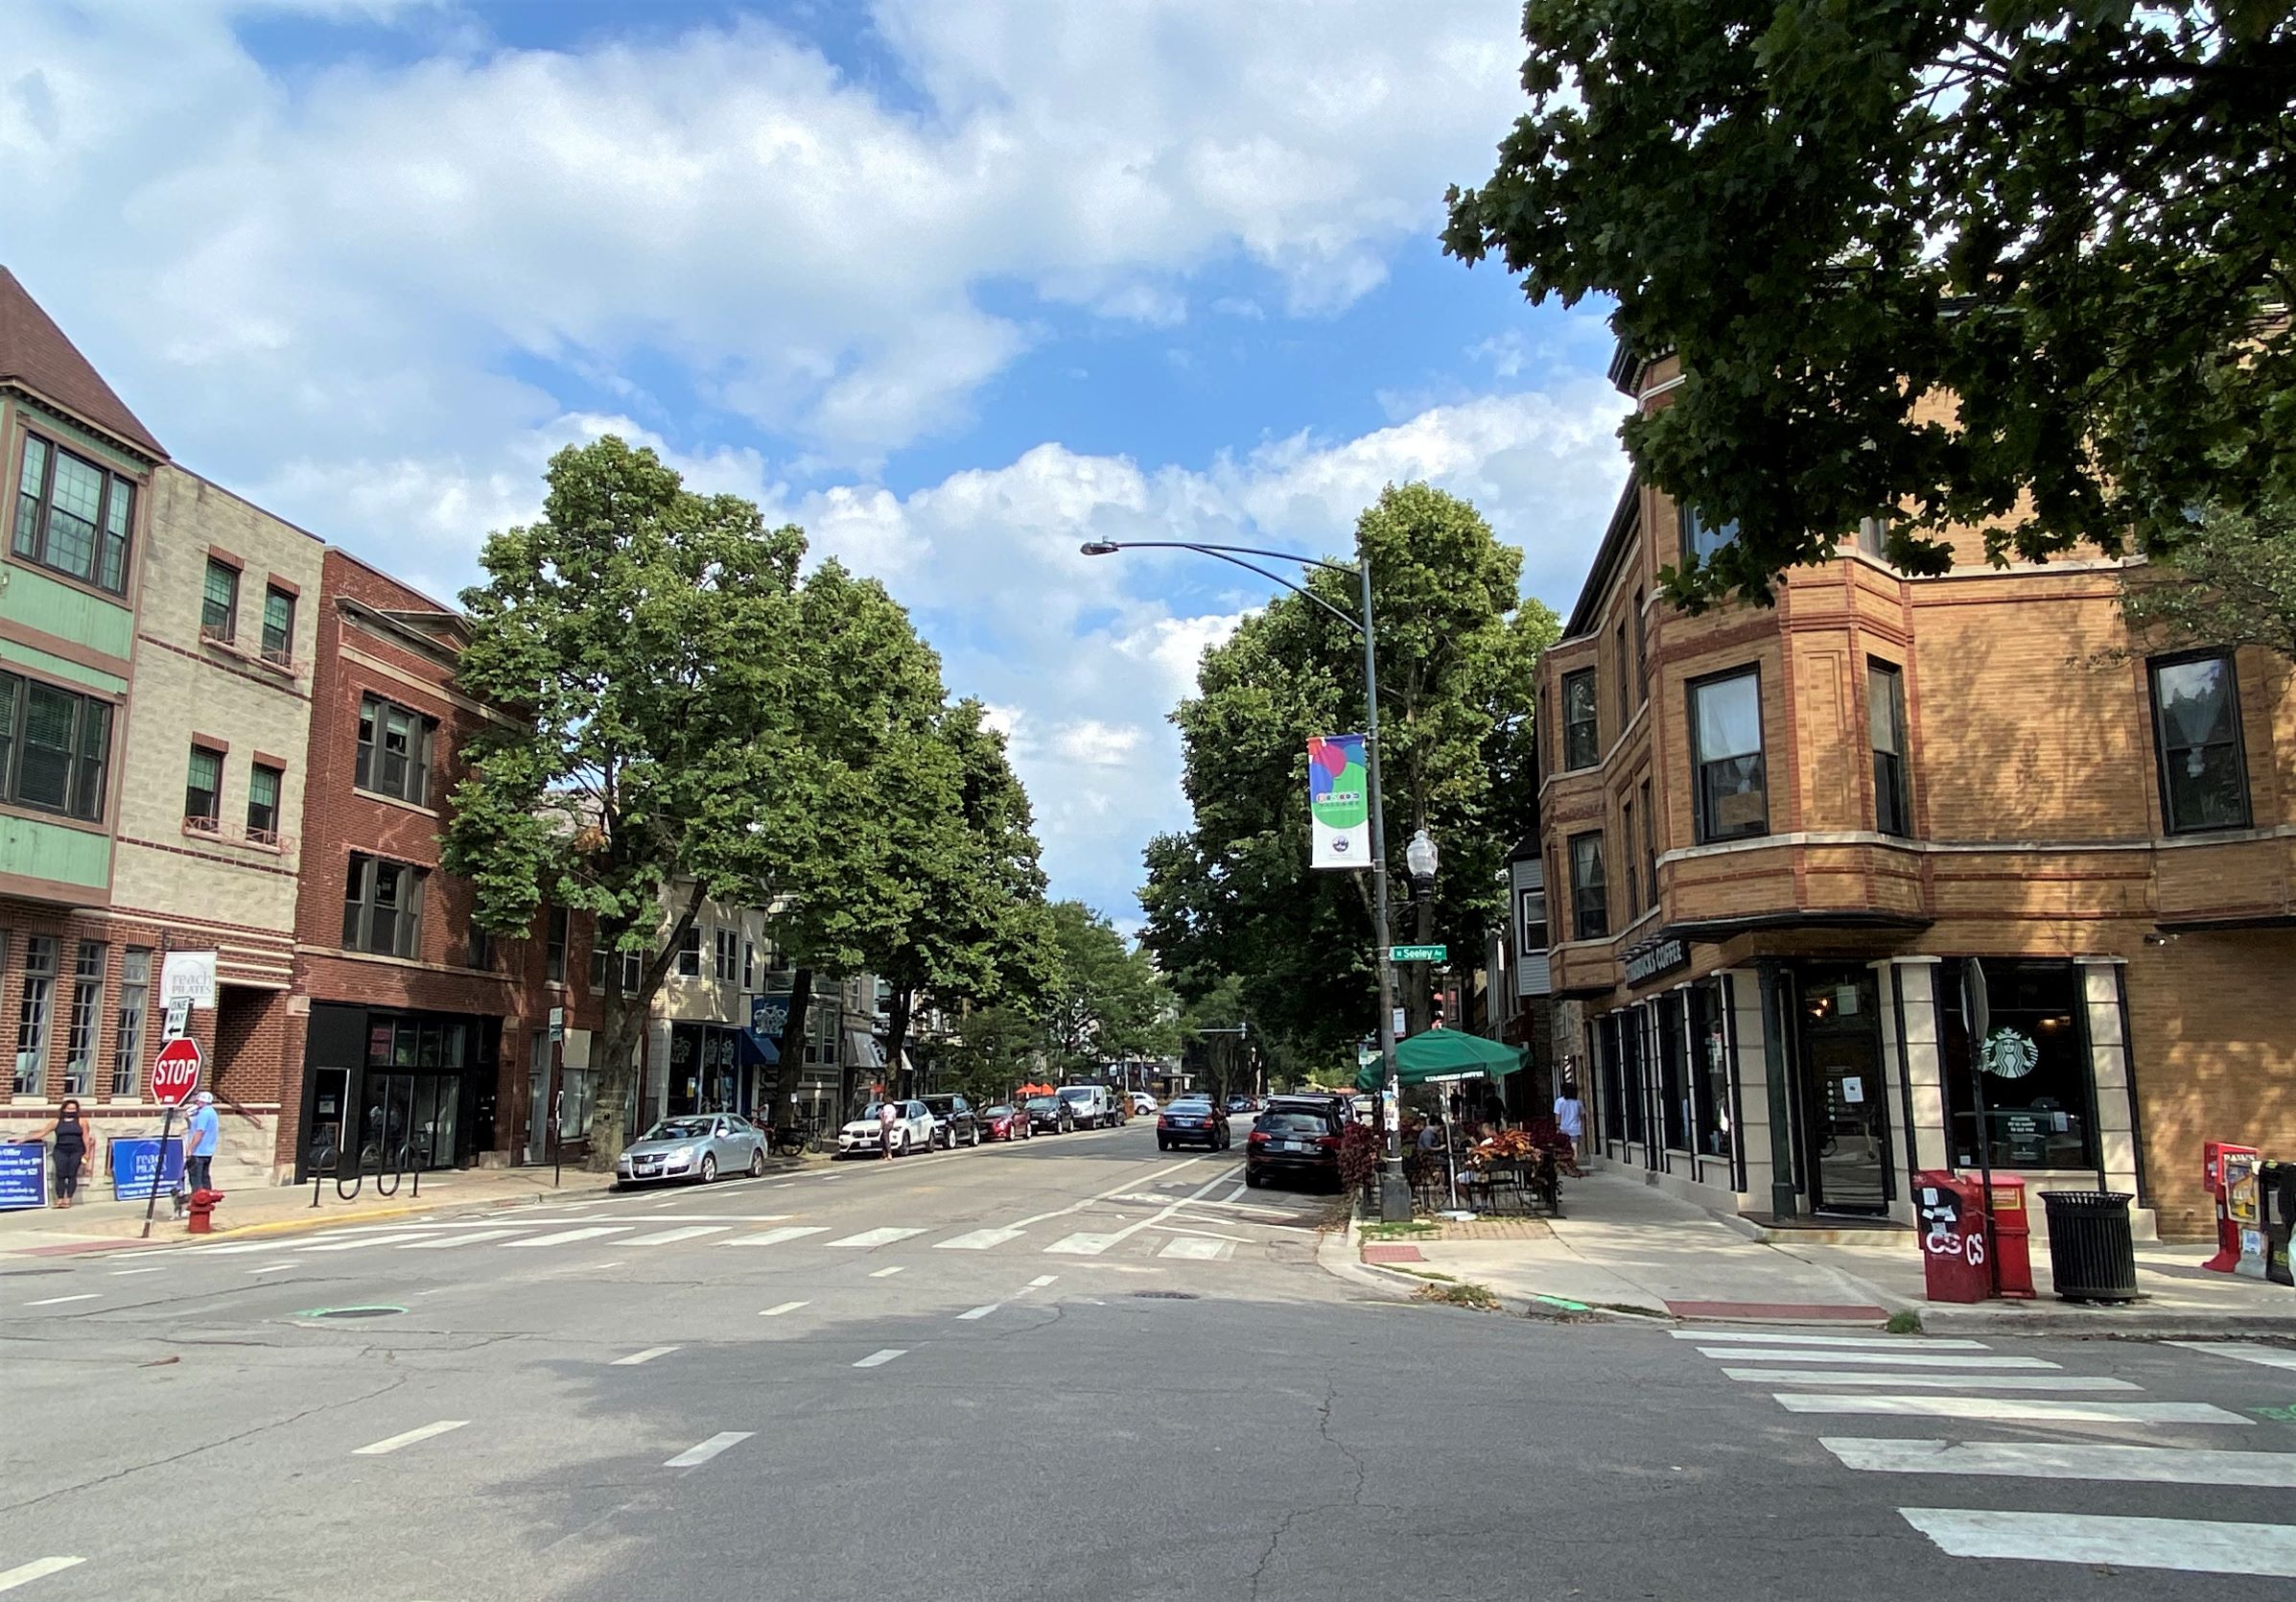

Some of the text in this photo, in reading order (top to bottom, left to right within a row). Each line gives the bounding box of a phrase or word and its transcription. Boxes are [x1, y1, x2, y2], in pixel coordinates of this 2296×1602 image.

[1403, 949, 1433, 960] Seeley
[172, 970, 212, 986] reach
[172, 983, 212, 996] PILATES
[170, 999, 188, 1011] ONE
[168, 1012, 186, 1024] WAY
[154, 1058, 198, 1086] STOP
[1966, 1233, 1984, 1266] CS
